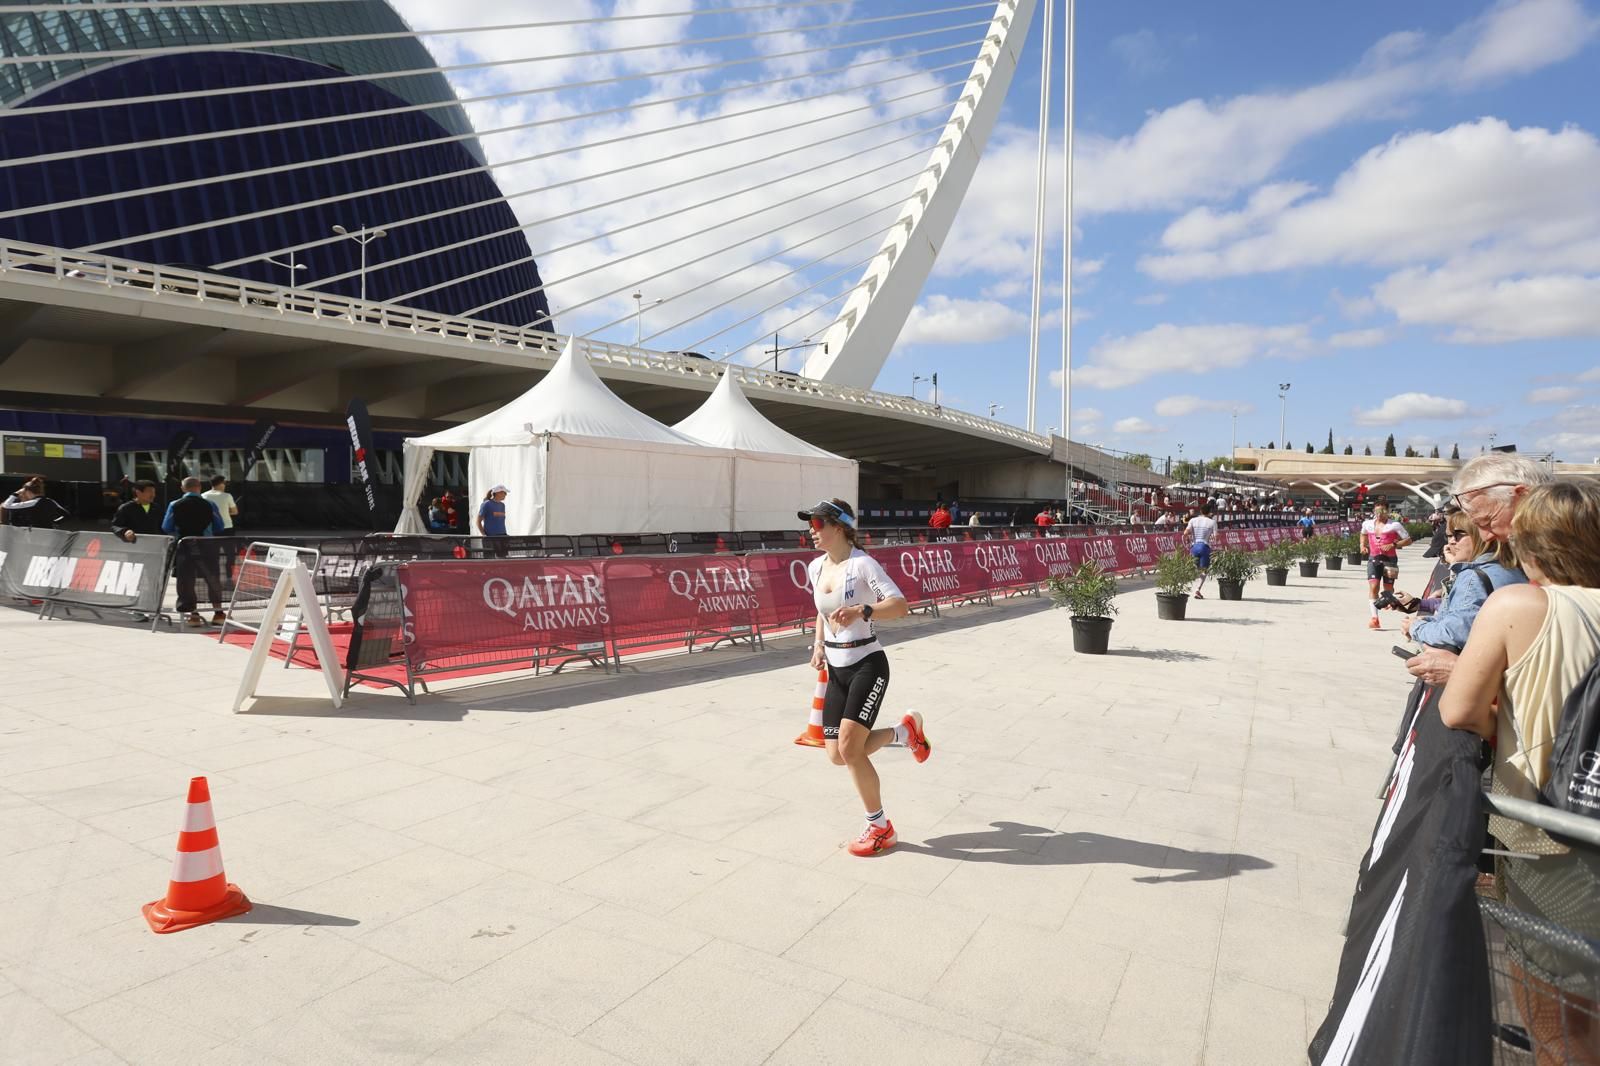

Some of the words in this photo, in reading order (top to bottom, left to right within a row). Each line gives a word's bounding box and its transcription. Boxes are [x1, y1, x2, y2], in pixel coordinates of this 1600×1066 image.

[975, 545, 1019, 573] QATAR
[1035, 542, 1070, 566] QATAR
[1084, 539, 1115, 561] QATAR
[22, 555, 144, 597] IRONMAN
[900, 549, 956, 582] QATAR
[991, 567, 1023, 583] AIRWAYS
[482, 574, 607, 618] QATAR
[669, 567, 754, 601] QATAR
[922, 575, 960, 593] AIRWAYS
[698, 594, 760, 613] AIRWAYS
[523, 606, 610, 631] AIRWAYS
[859, 676, 885, 721] BINDER
[1569, 780, 1600, 798] HOLI
